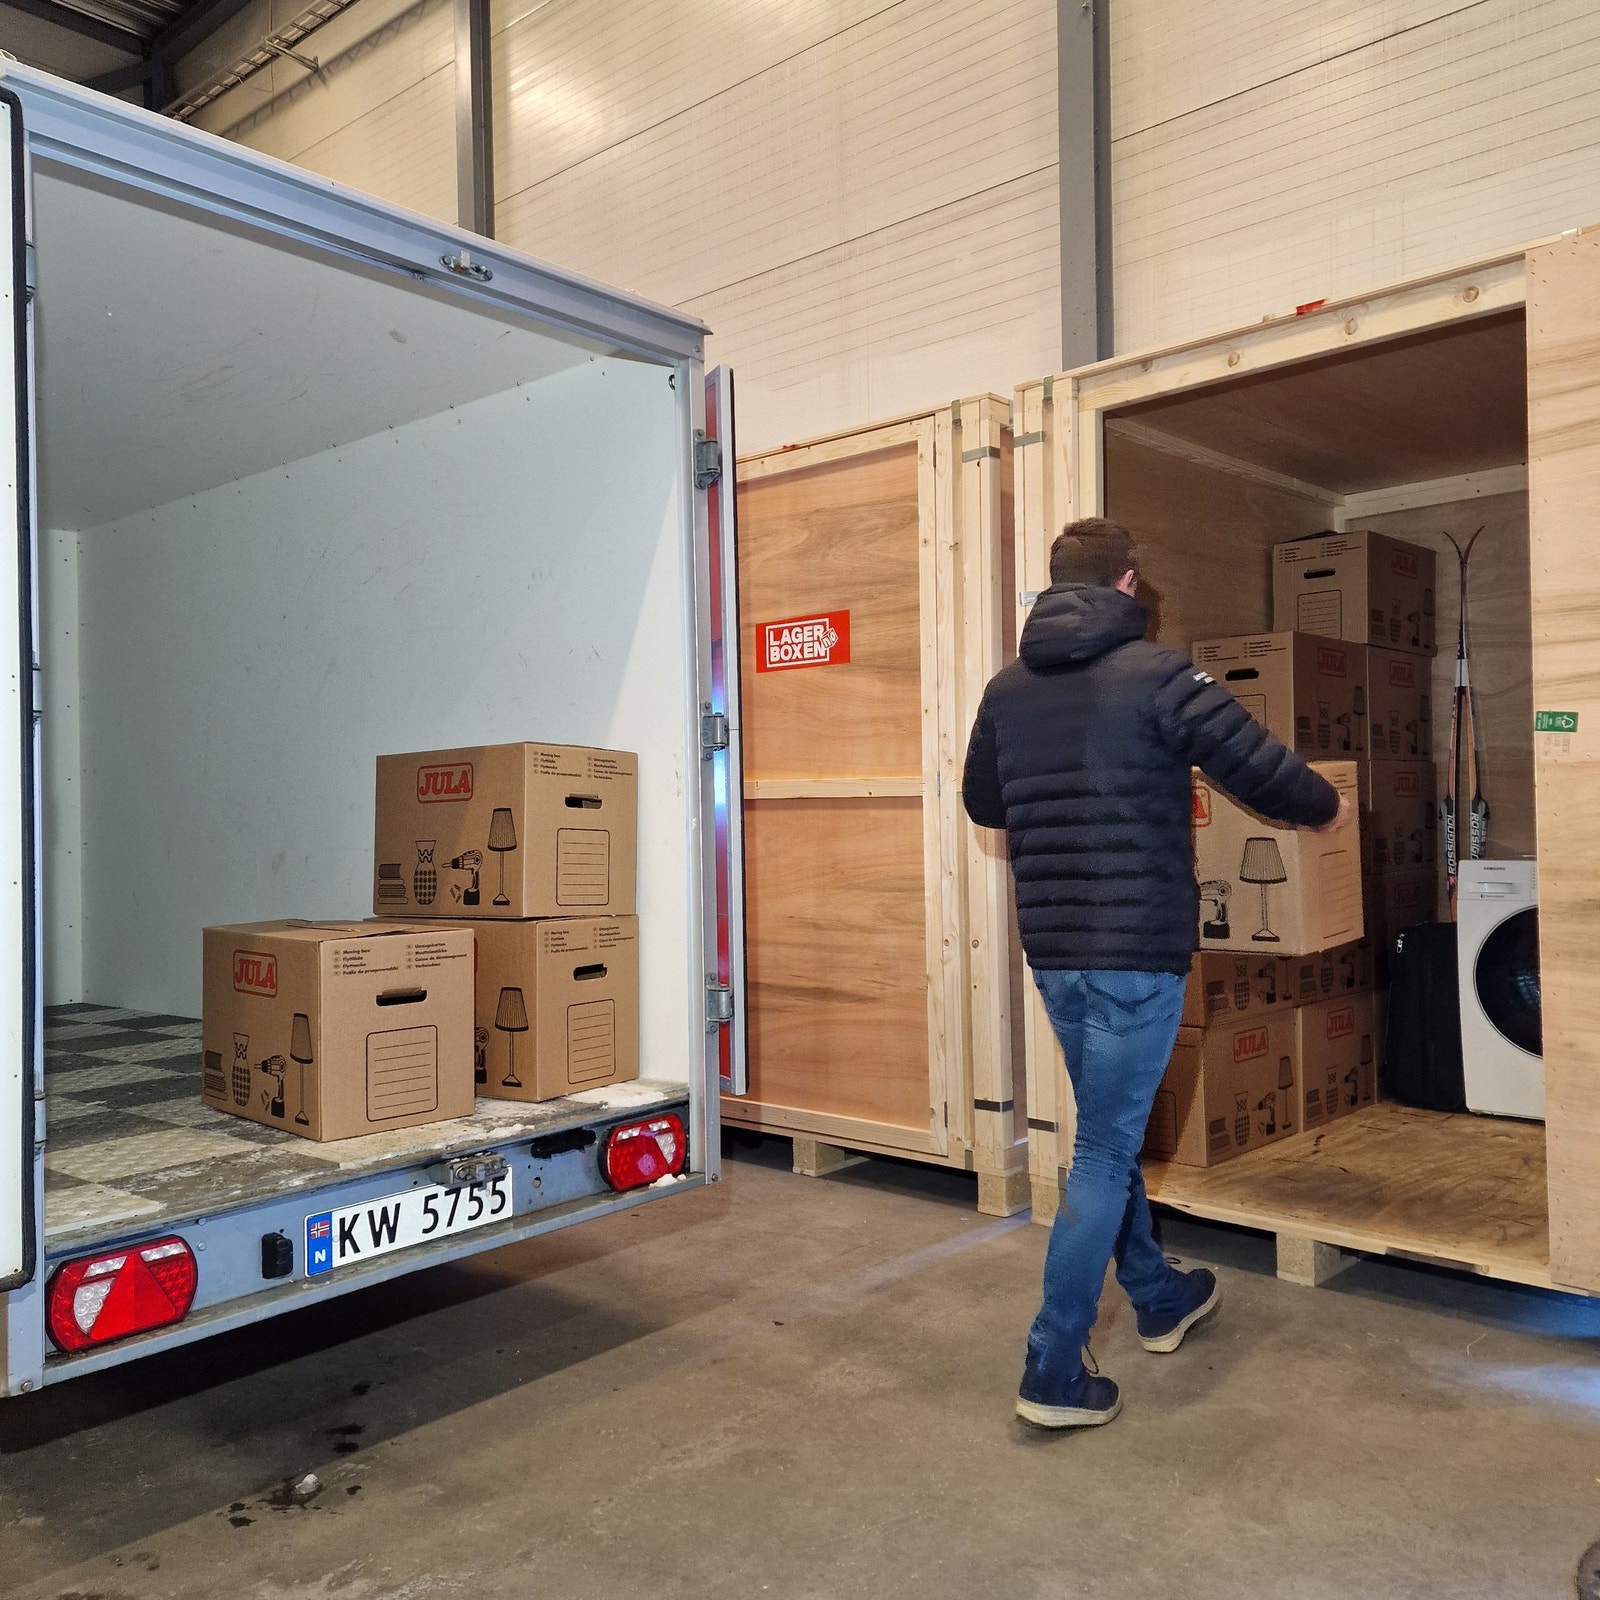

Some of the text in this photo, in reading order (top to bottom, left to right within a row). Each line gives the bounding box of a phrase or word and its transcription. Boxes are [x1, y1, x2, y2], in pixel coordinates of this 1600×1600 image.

[770, 624, 824, 645] LAGER
[770, 640, 825, 662] BOXEN
[420, 770, 470, 795] JULA
[1447, 814, 1456, 875] ROSSIGNOL
[235, 959, 276, 989] JULA
[1235, 1031, 1267, 1057] JULA
[339, 1175, 506, 1258] KW 5755
[314, 1249, 326, 1264] N
